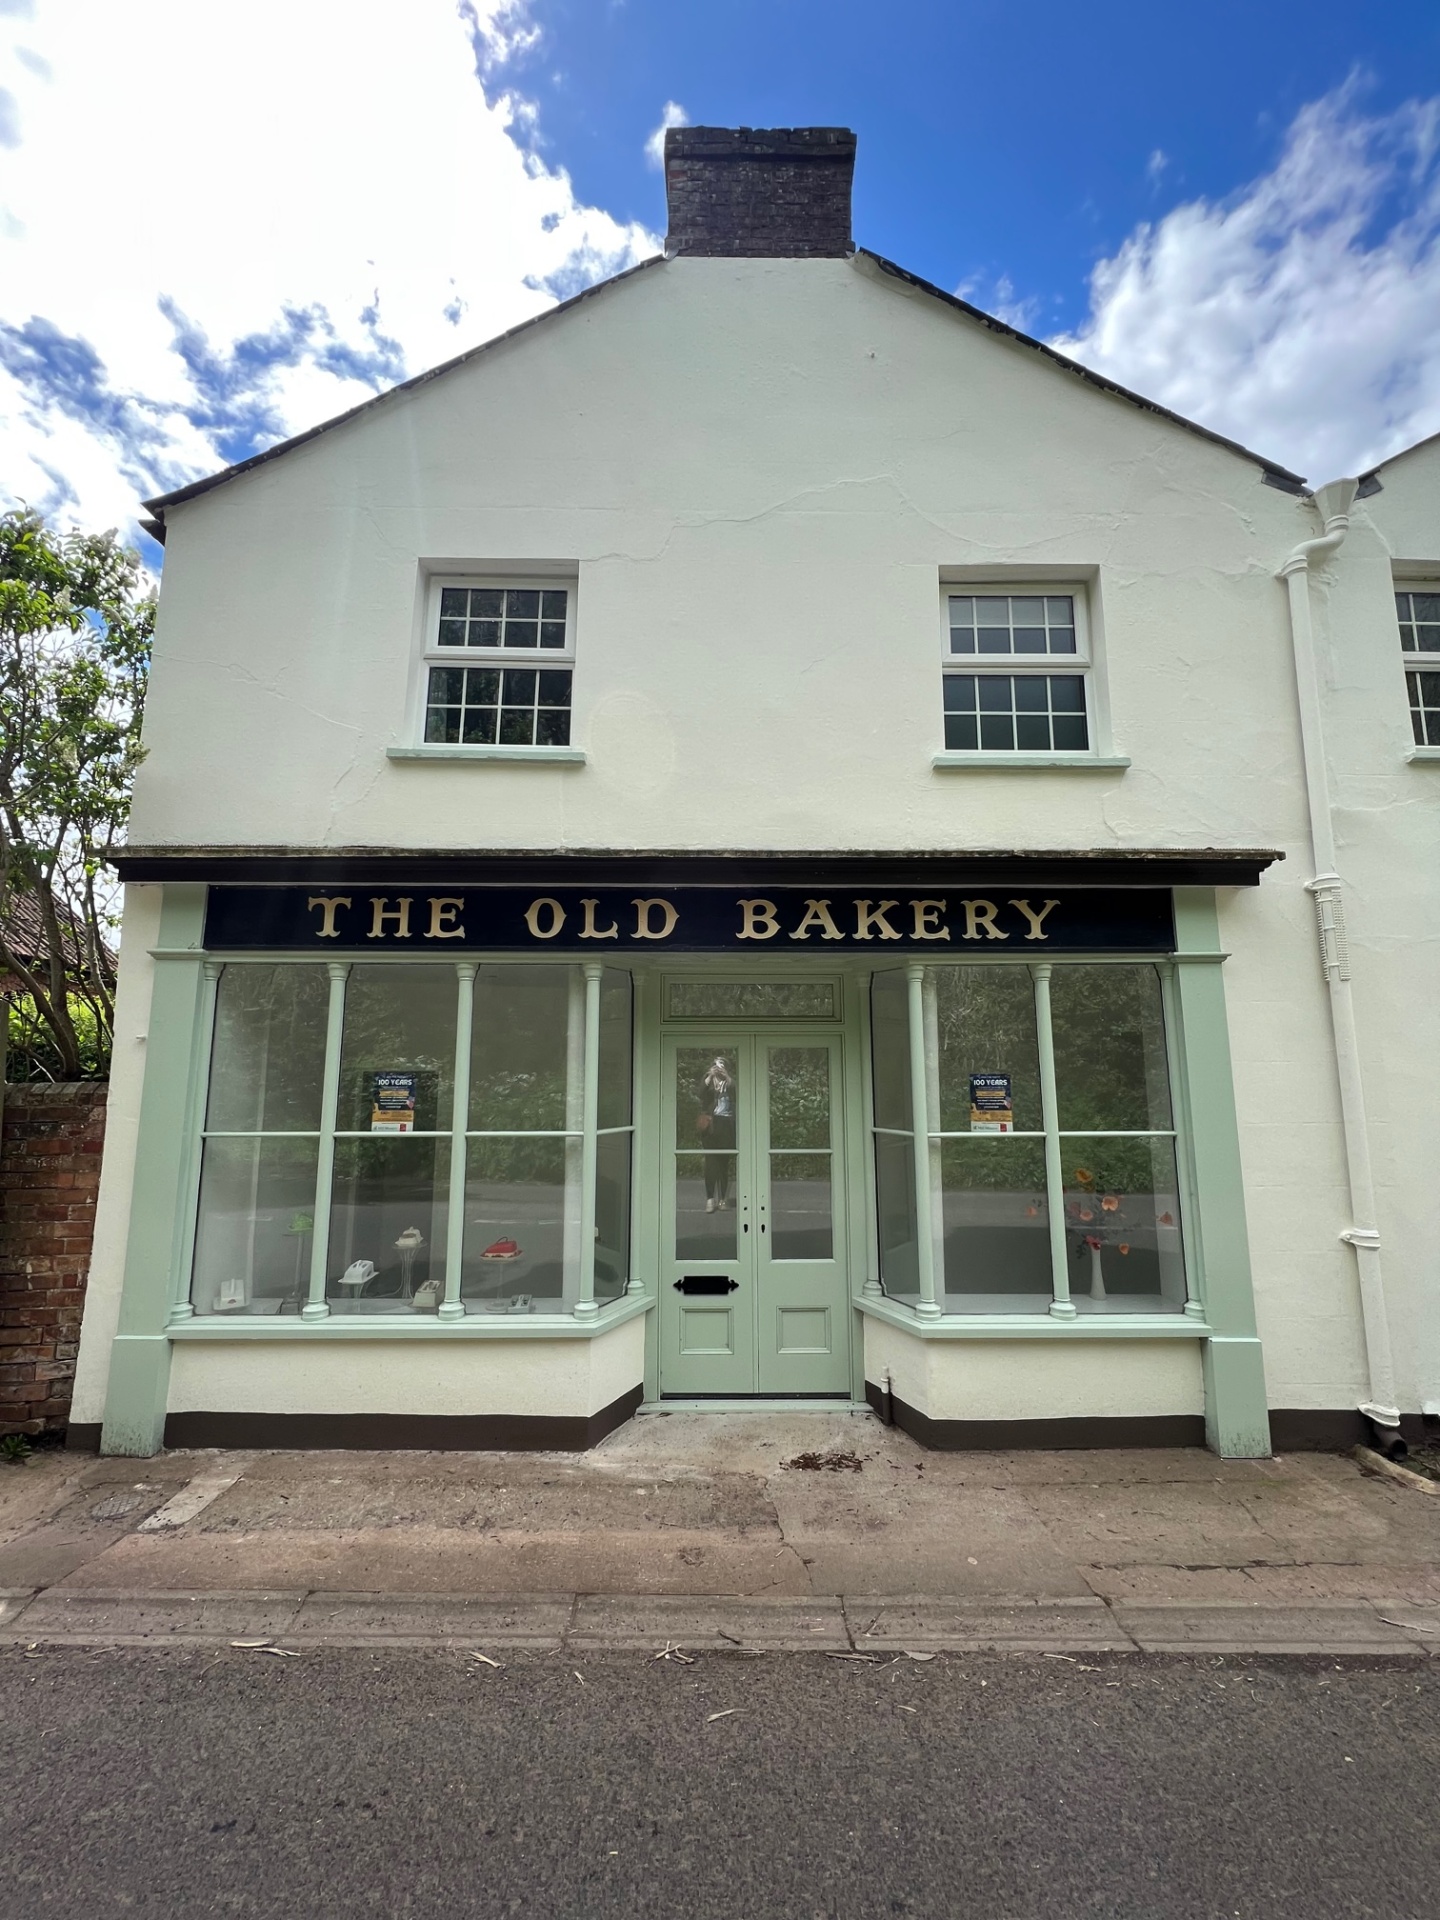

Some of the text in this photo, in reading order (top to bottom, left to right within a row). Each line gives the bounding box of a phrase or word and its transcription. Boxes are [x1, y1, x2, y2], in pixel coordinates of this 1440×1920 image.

[308, 896, 1061, 942] THE OLD BAKERY
